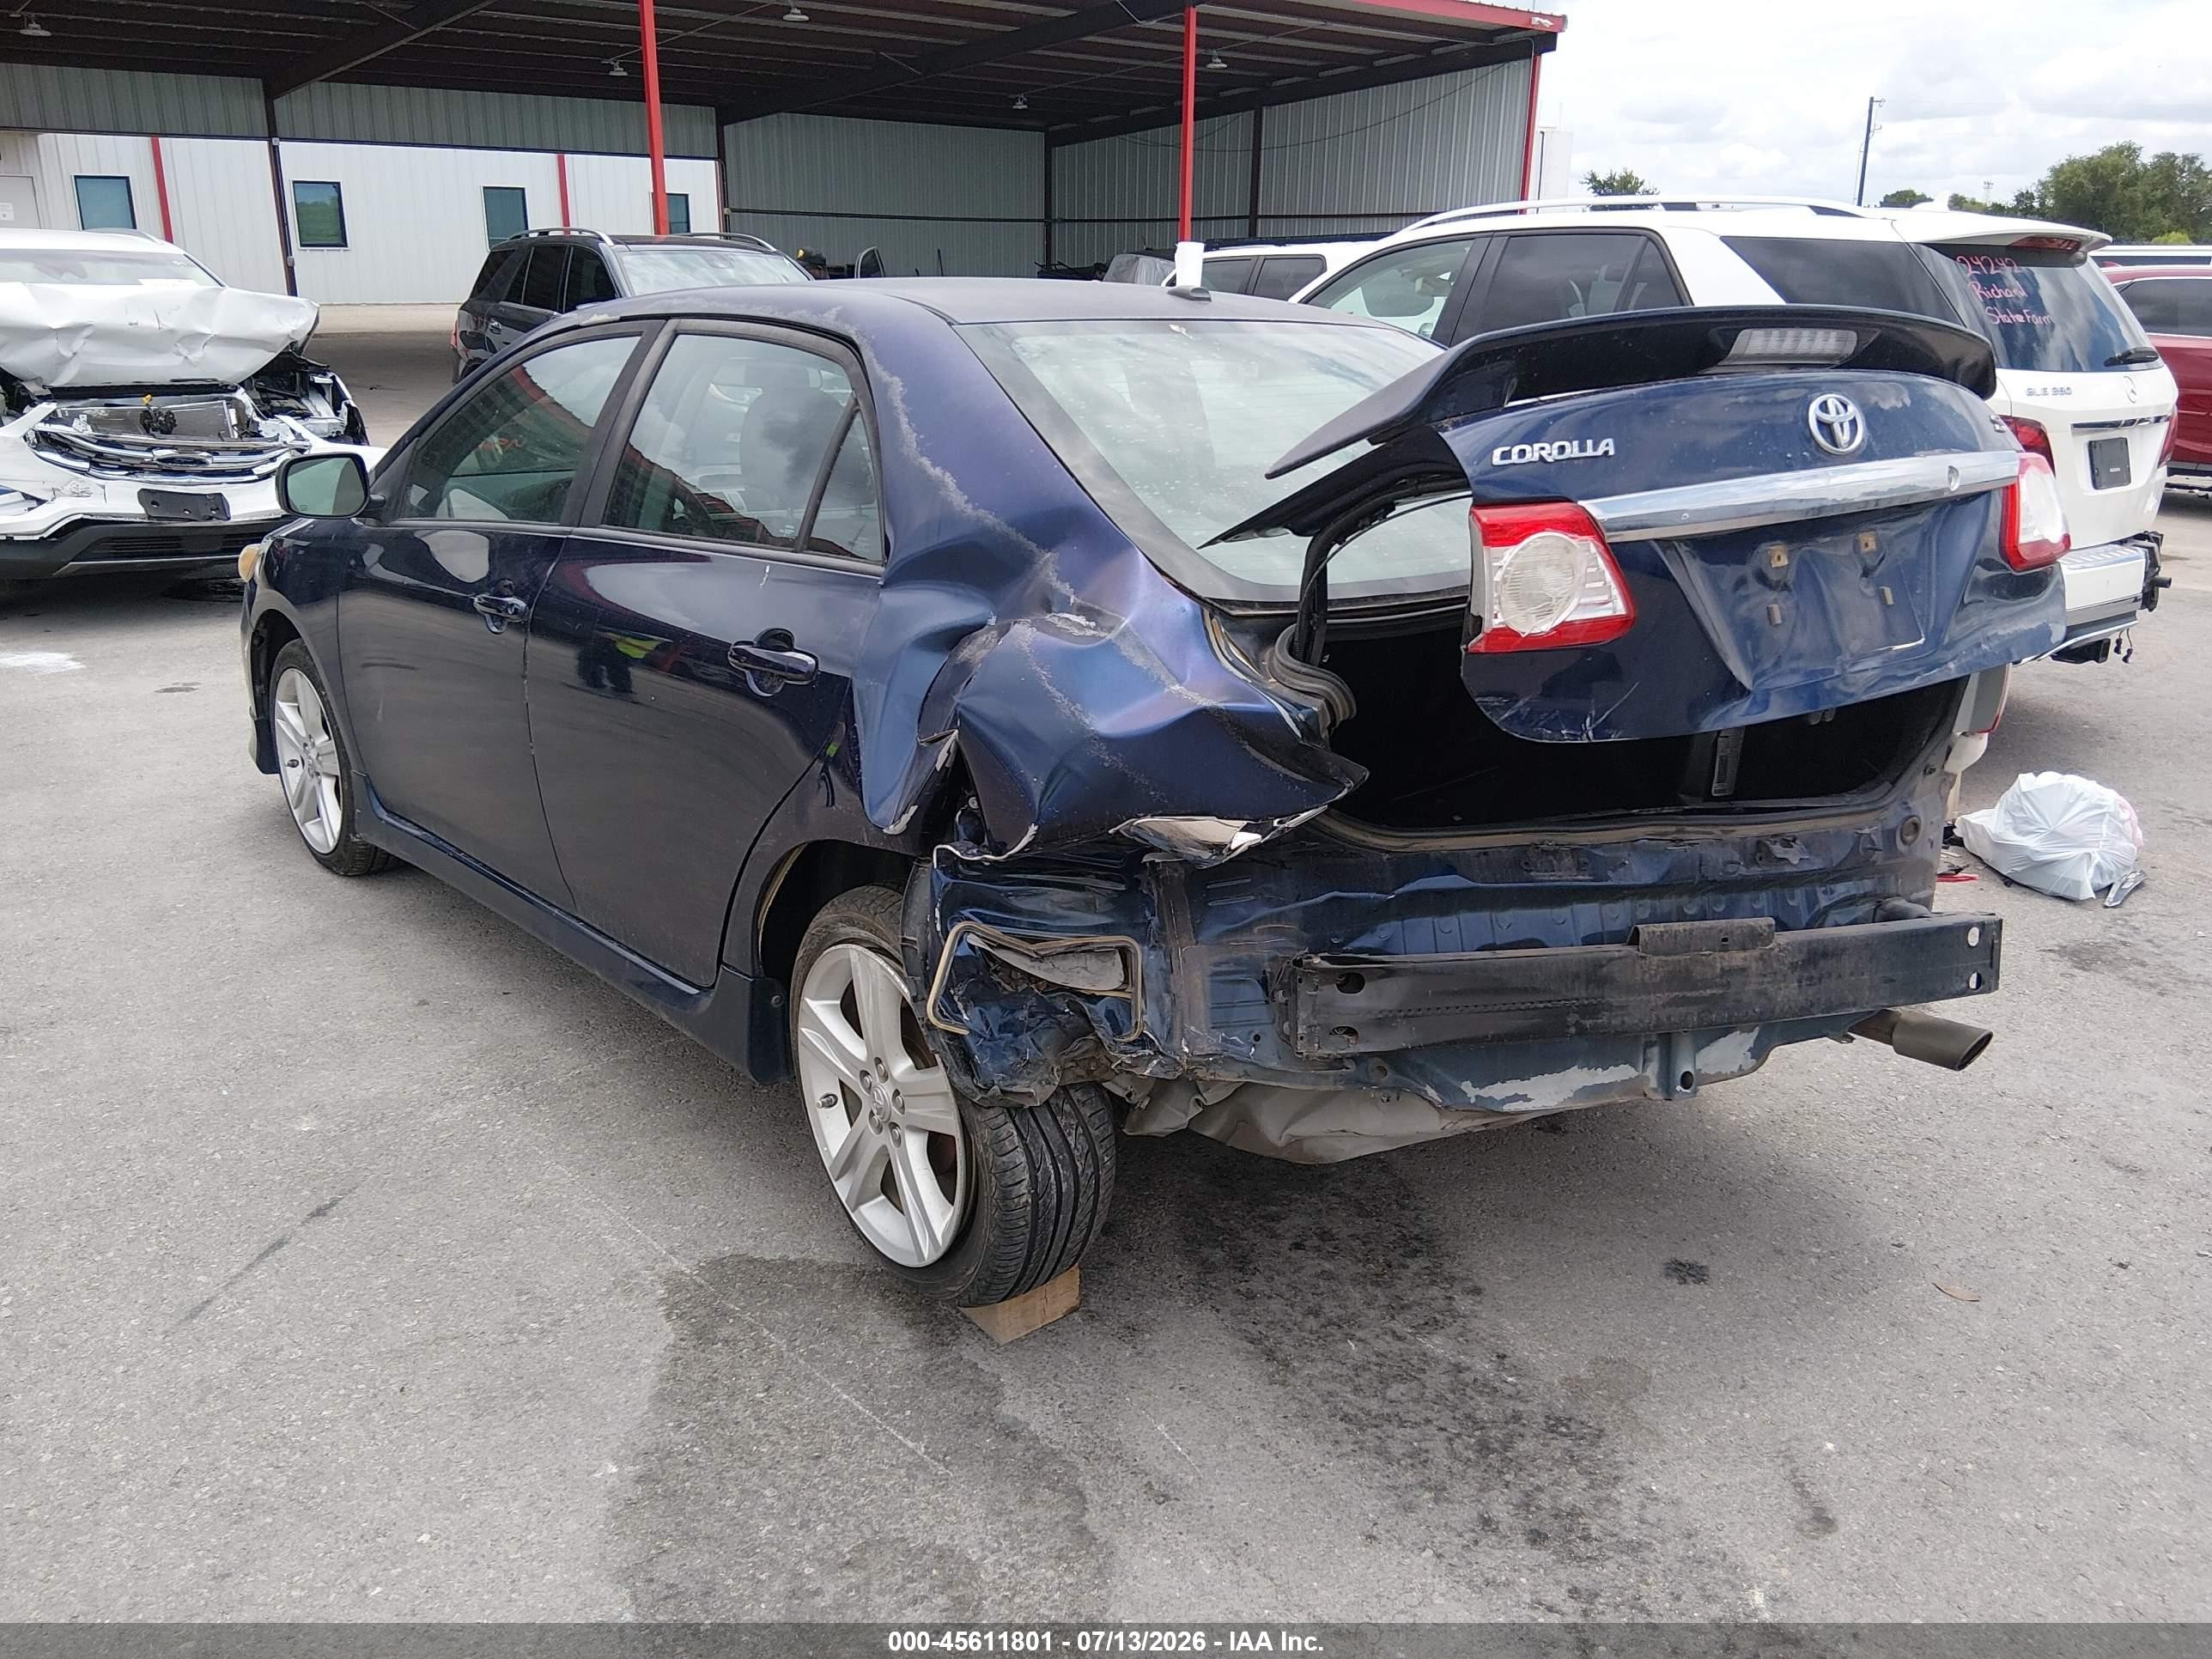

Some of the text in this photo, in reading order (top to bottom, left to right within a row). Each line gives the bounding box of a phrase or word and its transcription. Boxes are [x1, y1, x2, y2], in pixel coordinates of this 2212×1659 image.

[1957, 255, 2022, 276] 24242
[1967, 281, 2028, 302] Richard
[1492, 438, 1615, 466] COROLLA
